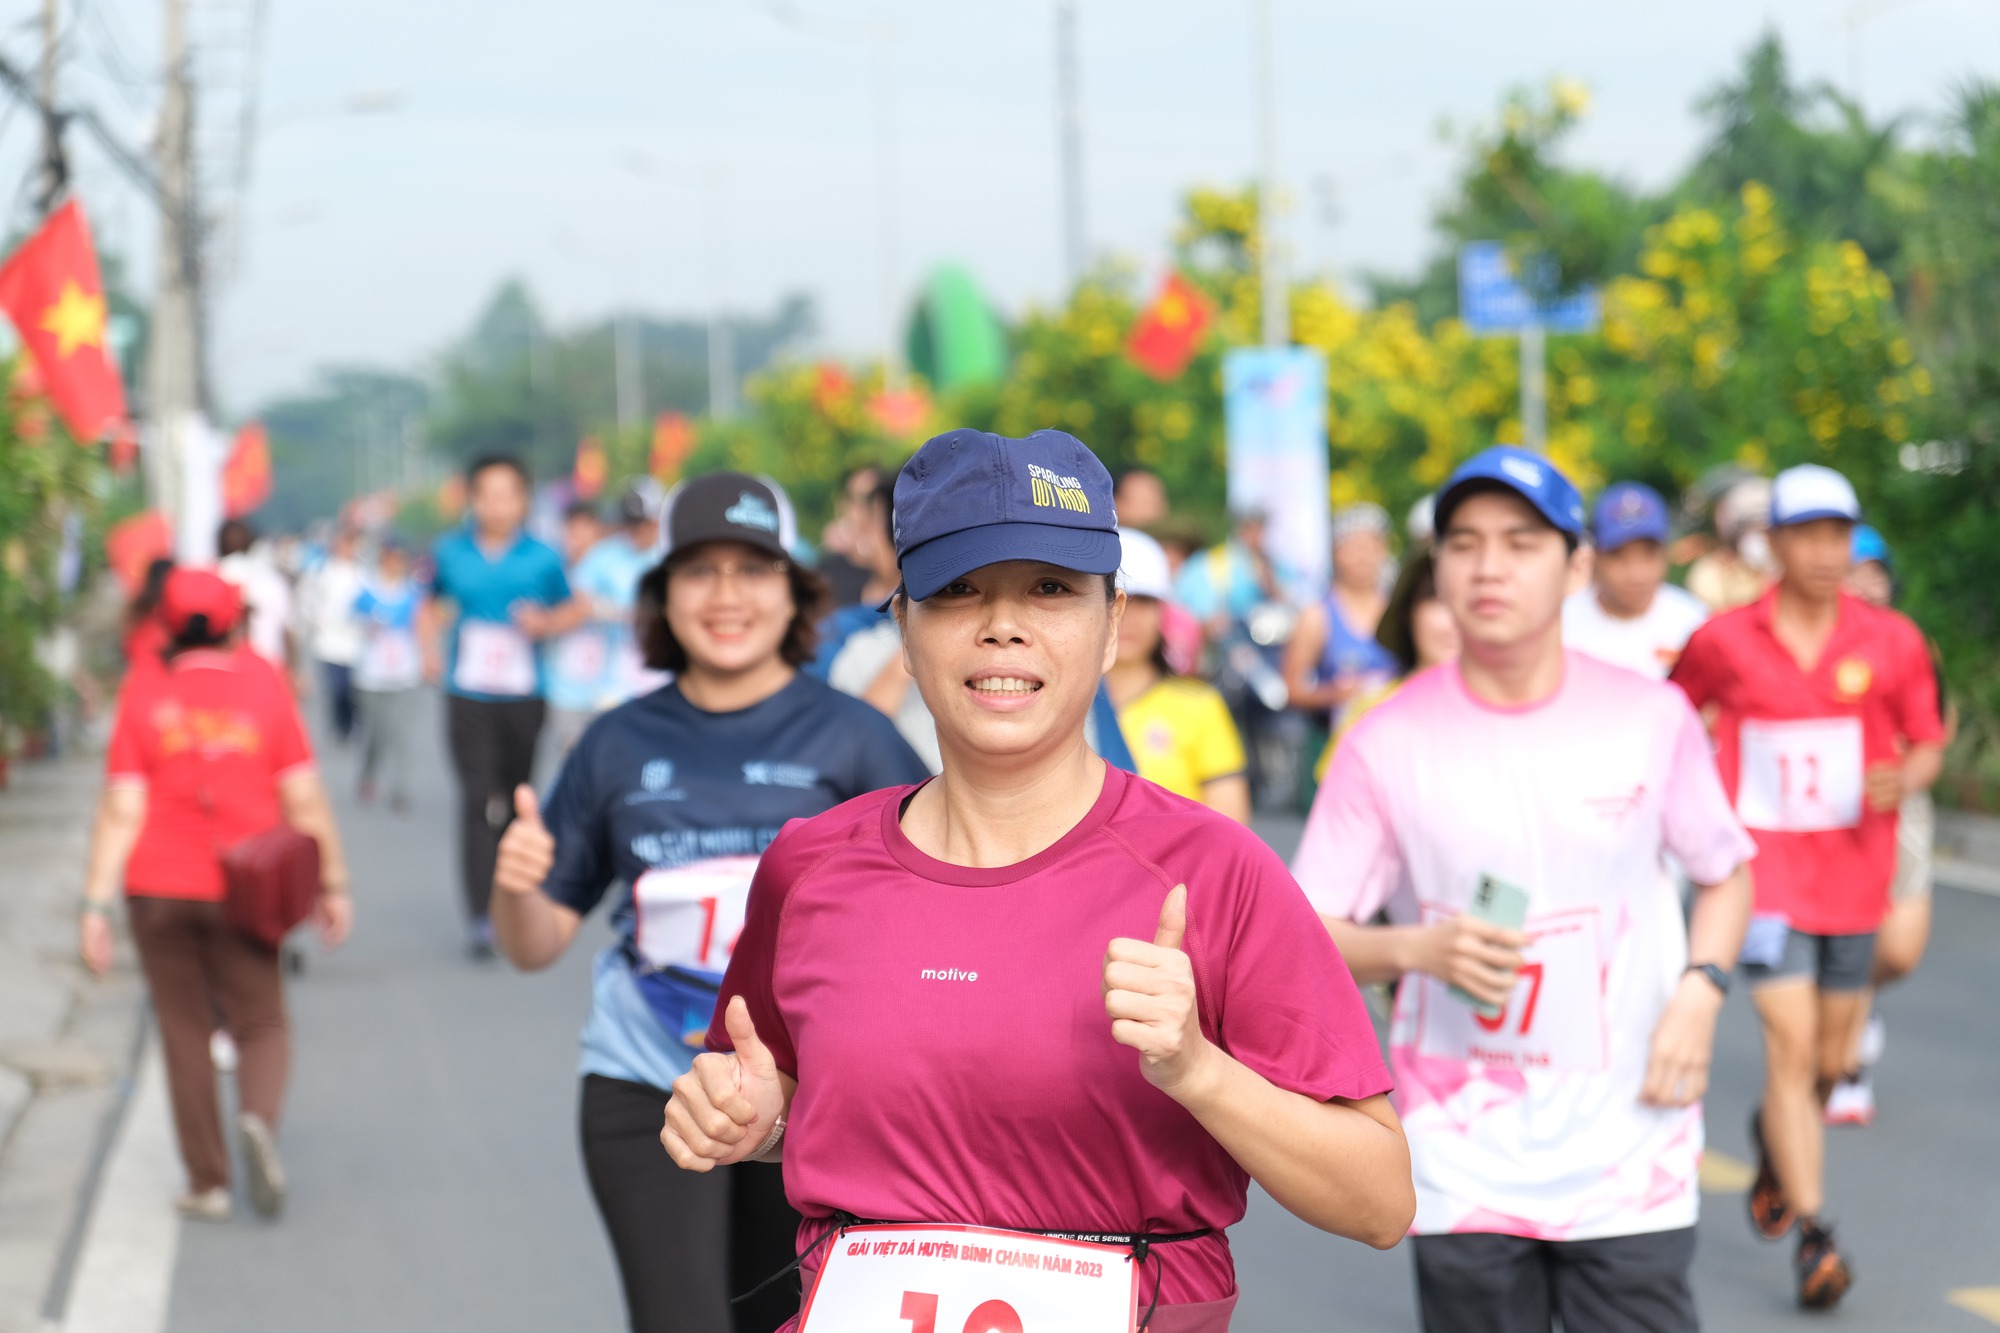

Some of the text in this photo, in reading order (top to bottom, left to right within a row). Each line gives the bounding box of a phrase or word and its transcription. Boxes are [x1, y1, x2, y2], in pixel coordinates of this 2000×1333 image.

[1027, 463, 1082, 489] SPARKLING
[1031, 477, 1056, 508] QUY
[698, 896, 746, 964] 1
[920, 968, 978, 982] motive
[1077, 1234, 1100, 1242] RACE
[1101, 1235, 1131, 1243] SERIES
[1074, 1260, 1103, 1279] 2023
